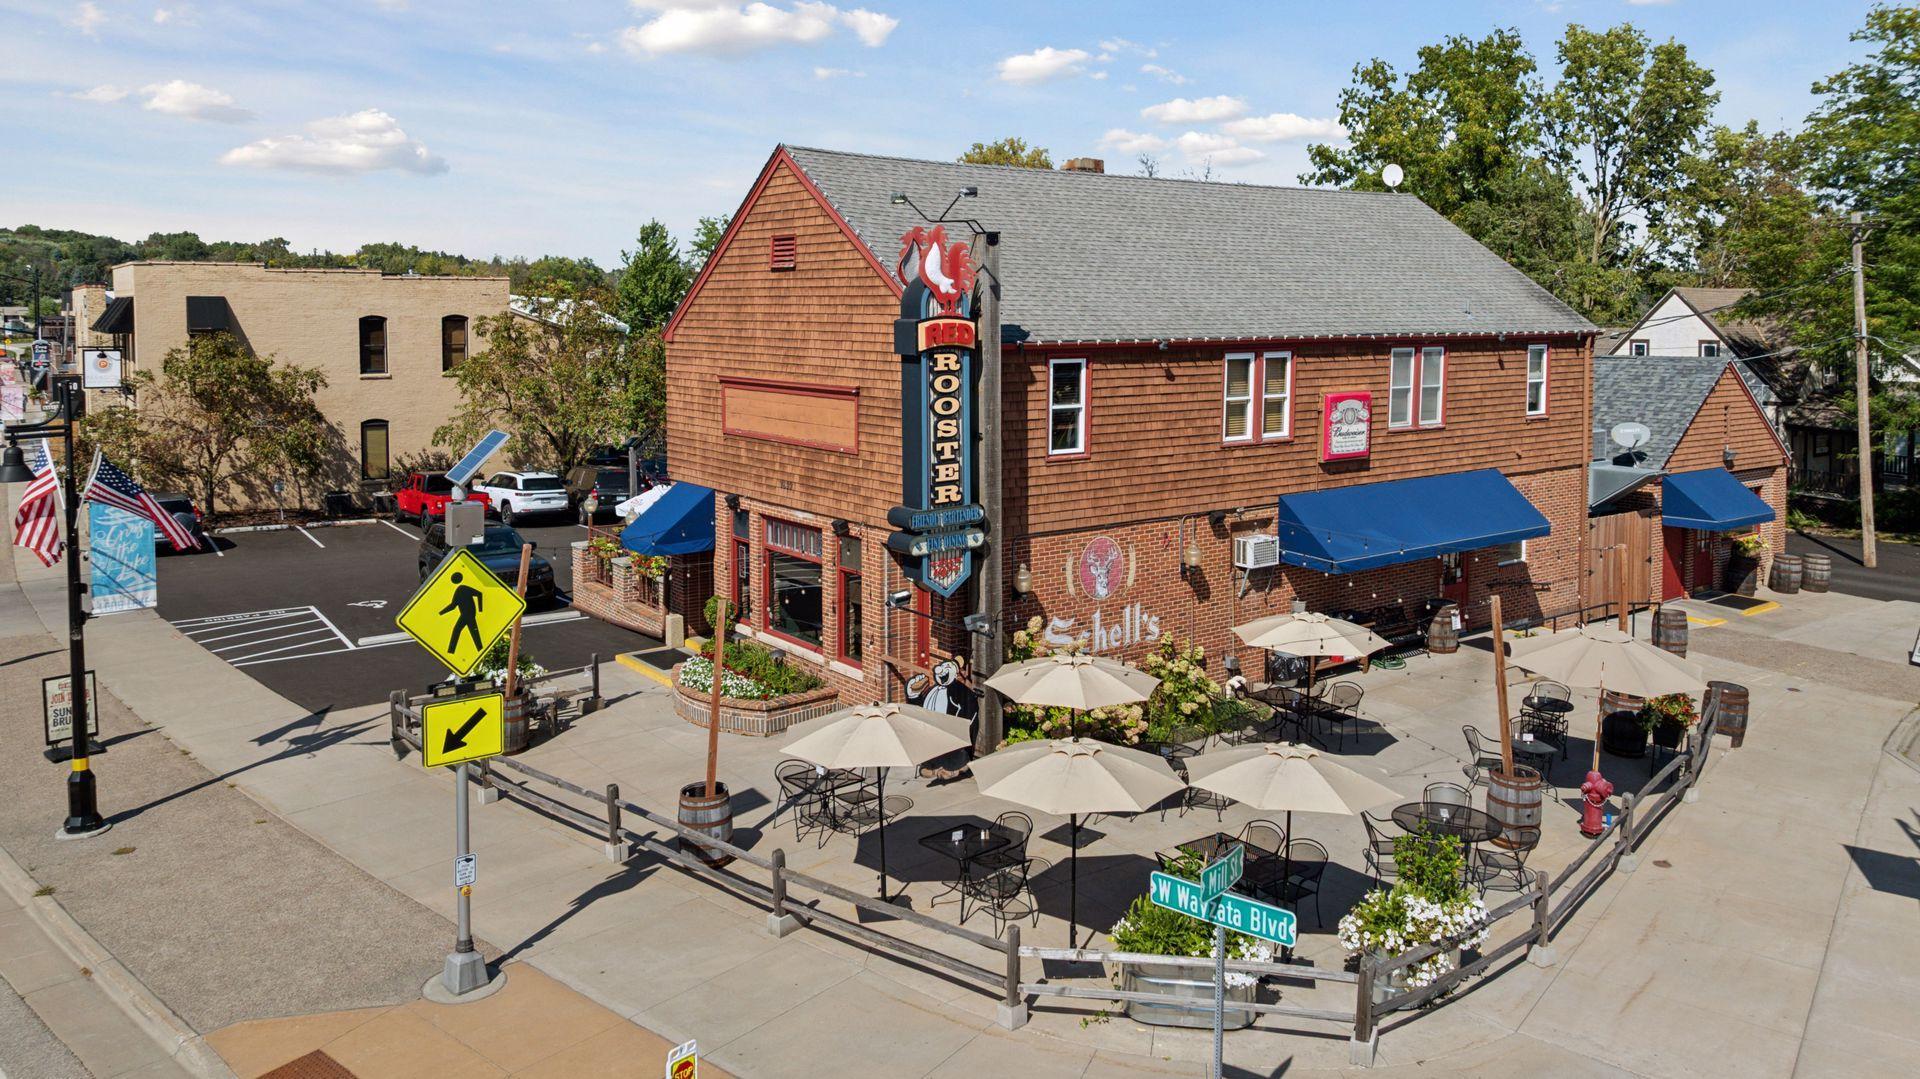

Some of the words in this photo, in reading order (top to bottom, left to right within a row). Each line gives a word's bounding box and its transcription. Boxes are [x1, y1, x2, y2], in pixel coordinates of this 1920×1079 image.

[924, 322, 975, 347] RED
[932, 353, 963, 505] ROOSTER
[1332, 426, 1365, 437] Budweiser
[115, 541, 138, 562] the
[1208, 860, 1229, 896] Mill
[1230, 855, 1240, 881] St
[1158, 878, 1172, 904] W
[1177, 884, 1242, 927] Wayzata
[1251, 907, 1288, 941] Blvd
[674, 1065, 694, 1079] STOP
